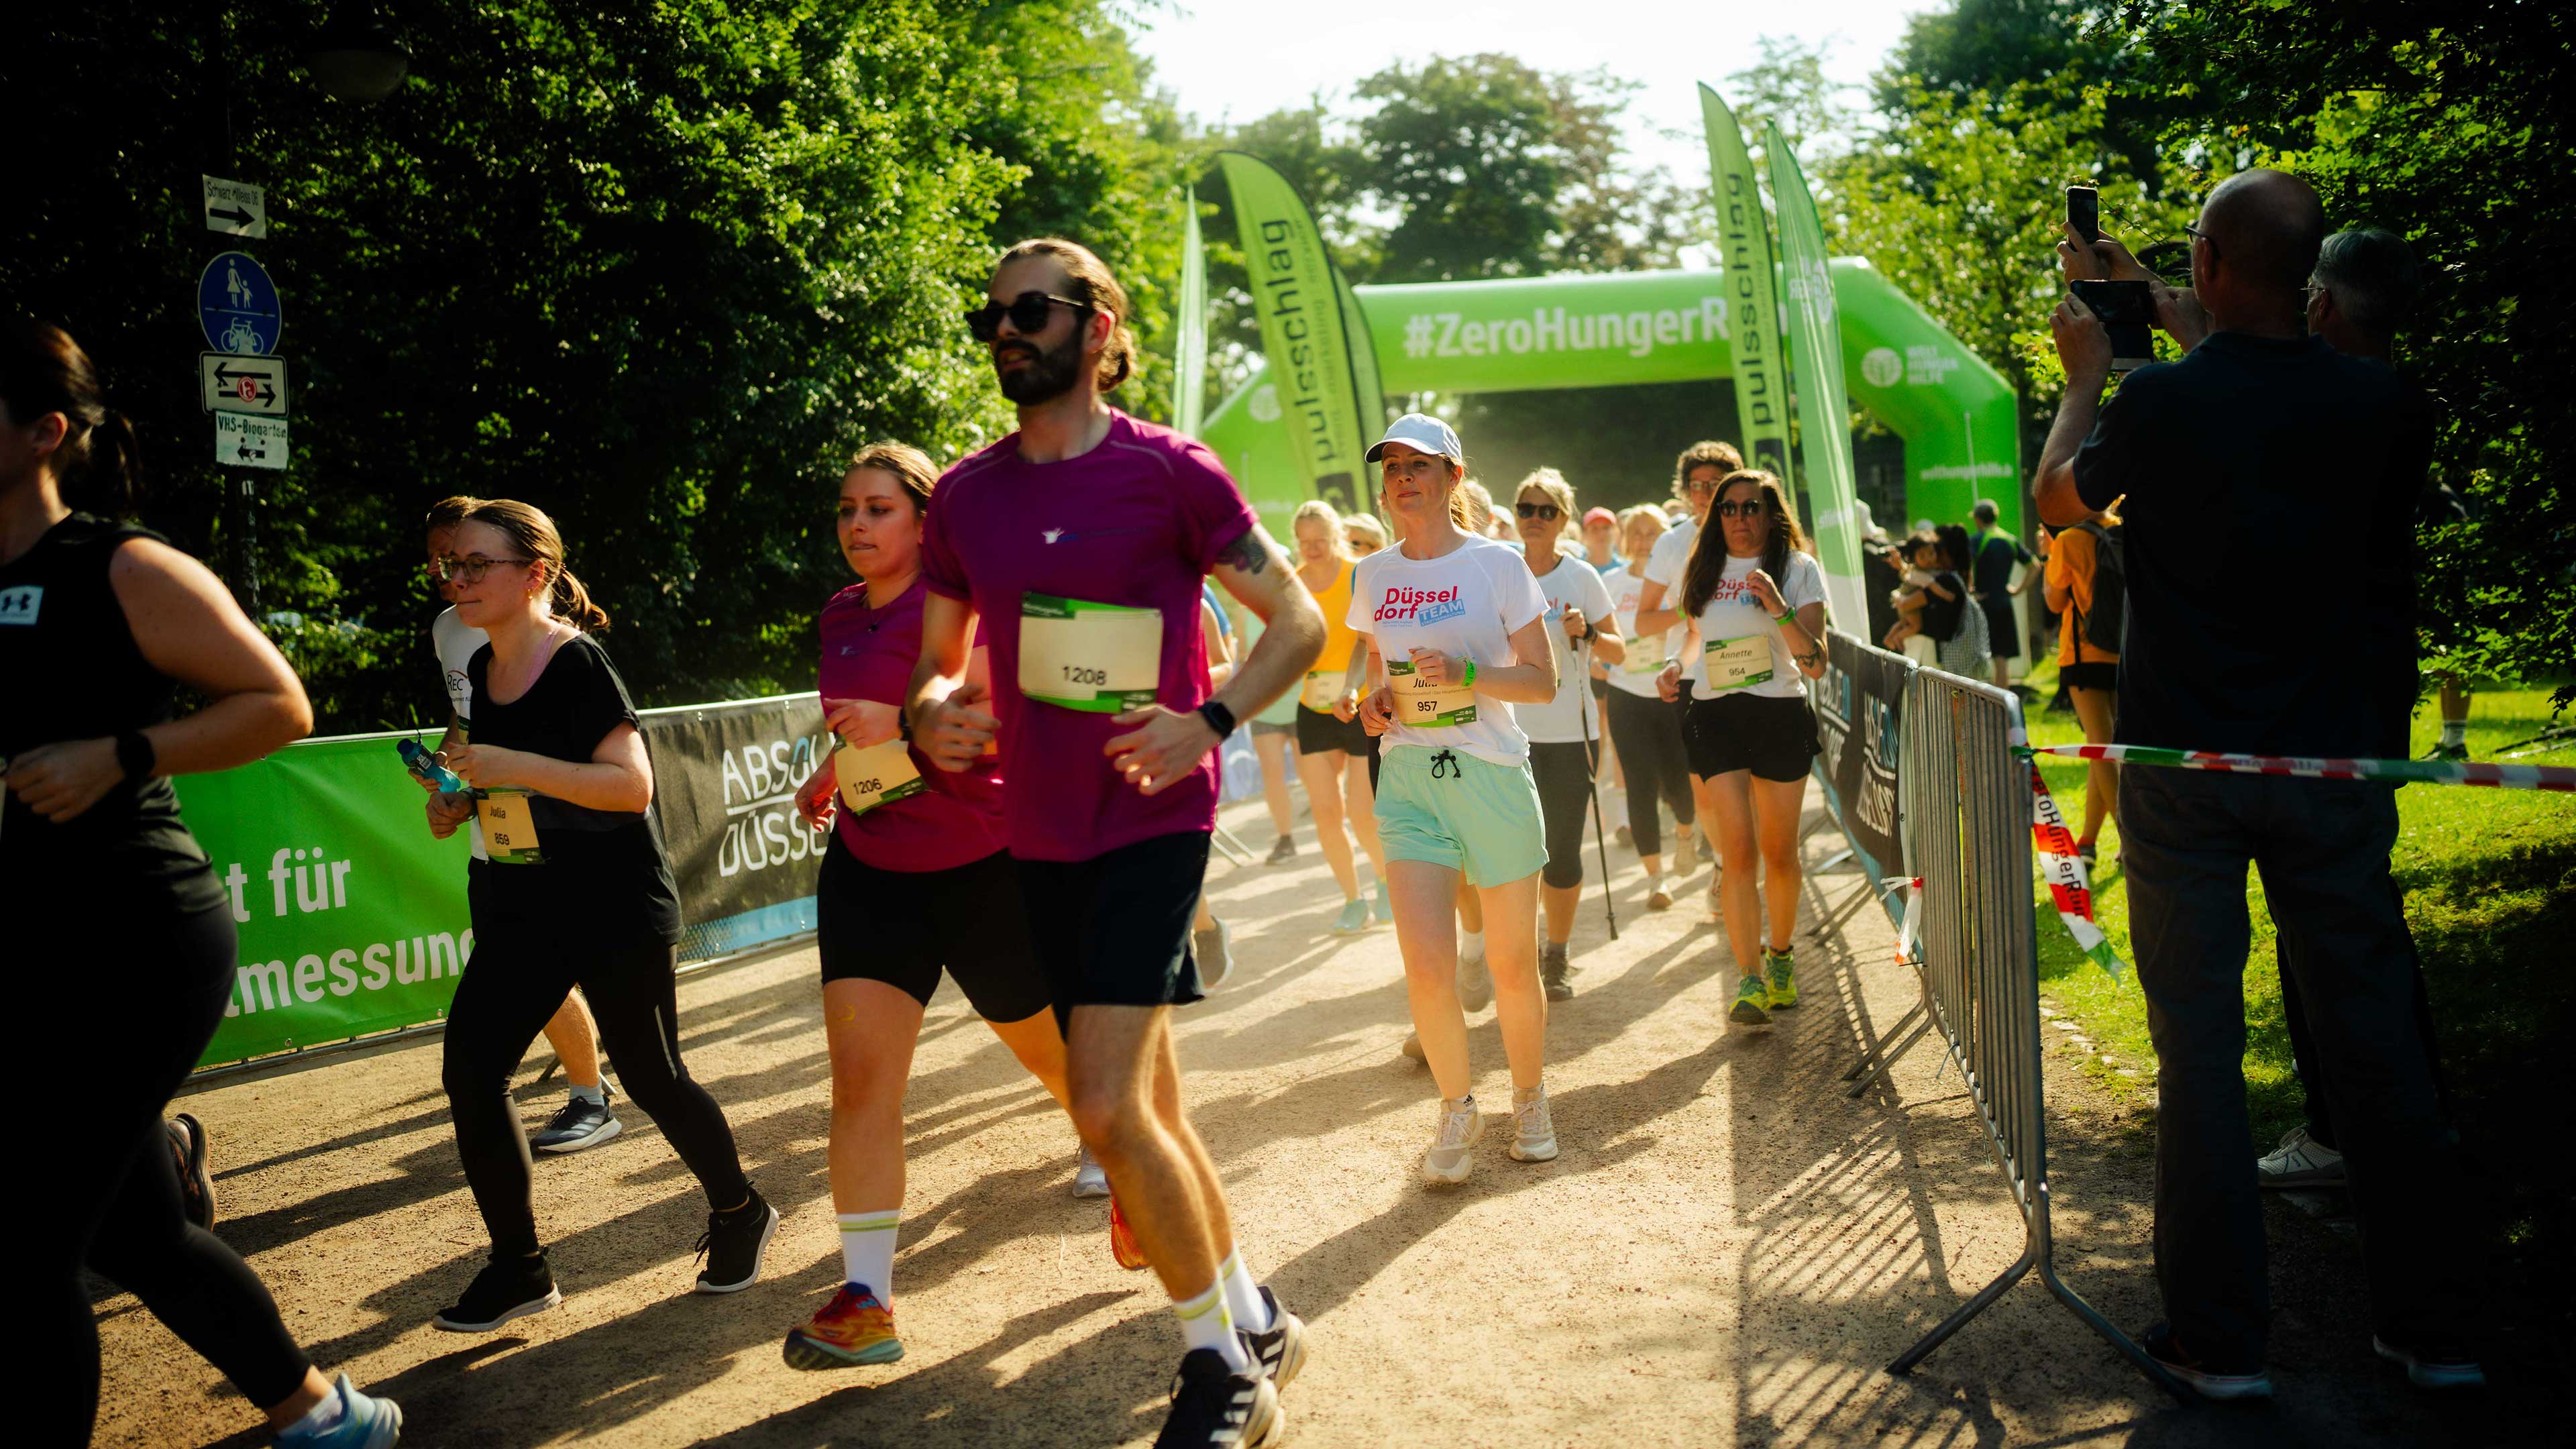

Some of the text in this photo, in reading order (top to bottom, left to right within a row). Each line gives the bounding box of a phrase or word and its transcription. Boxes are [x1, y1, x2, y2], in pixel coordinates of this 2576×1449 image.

[1727, 172, 1775, 425] pulsschlag
[1403, 296, 1787, 358] #ZeroHungerR
[1261, 219, 1336, 462] pulsschlag
[1385, 586, 1458, 604] Düssel
[1711, 588, 1739, 601] orf
[1374, 602, 1419, 621] dorf
[1419, 600, 1464, 621] TEAM
[1719, 649, 1753, 660] Annette
[1063, 665, 1107, 686] 1208
[1729, 667, 1746, 677] 954
[1417, 700, 1438, 712] 957
[722, 731, 837, 805] ABSOL
[853, 778, 883, 795] 1206
[490, 806, 506, 819] Julia
[494, 833, 510, 846] 859
[718, 798, 837, 877] DÜSSE
[2033, 769, 2085, 917] eroHungerRun
[268, 847, 351, 917] für
